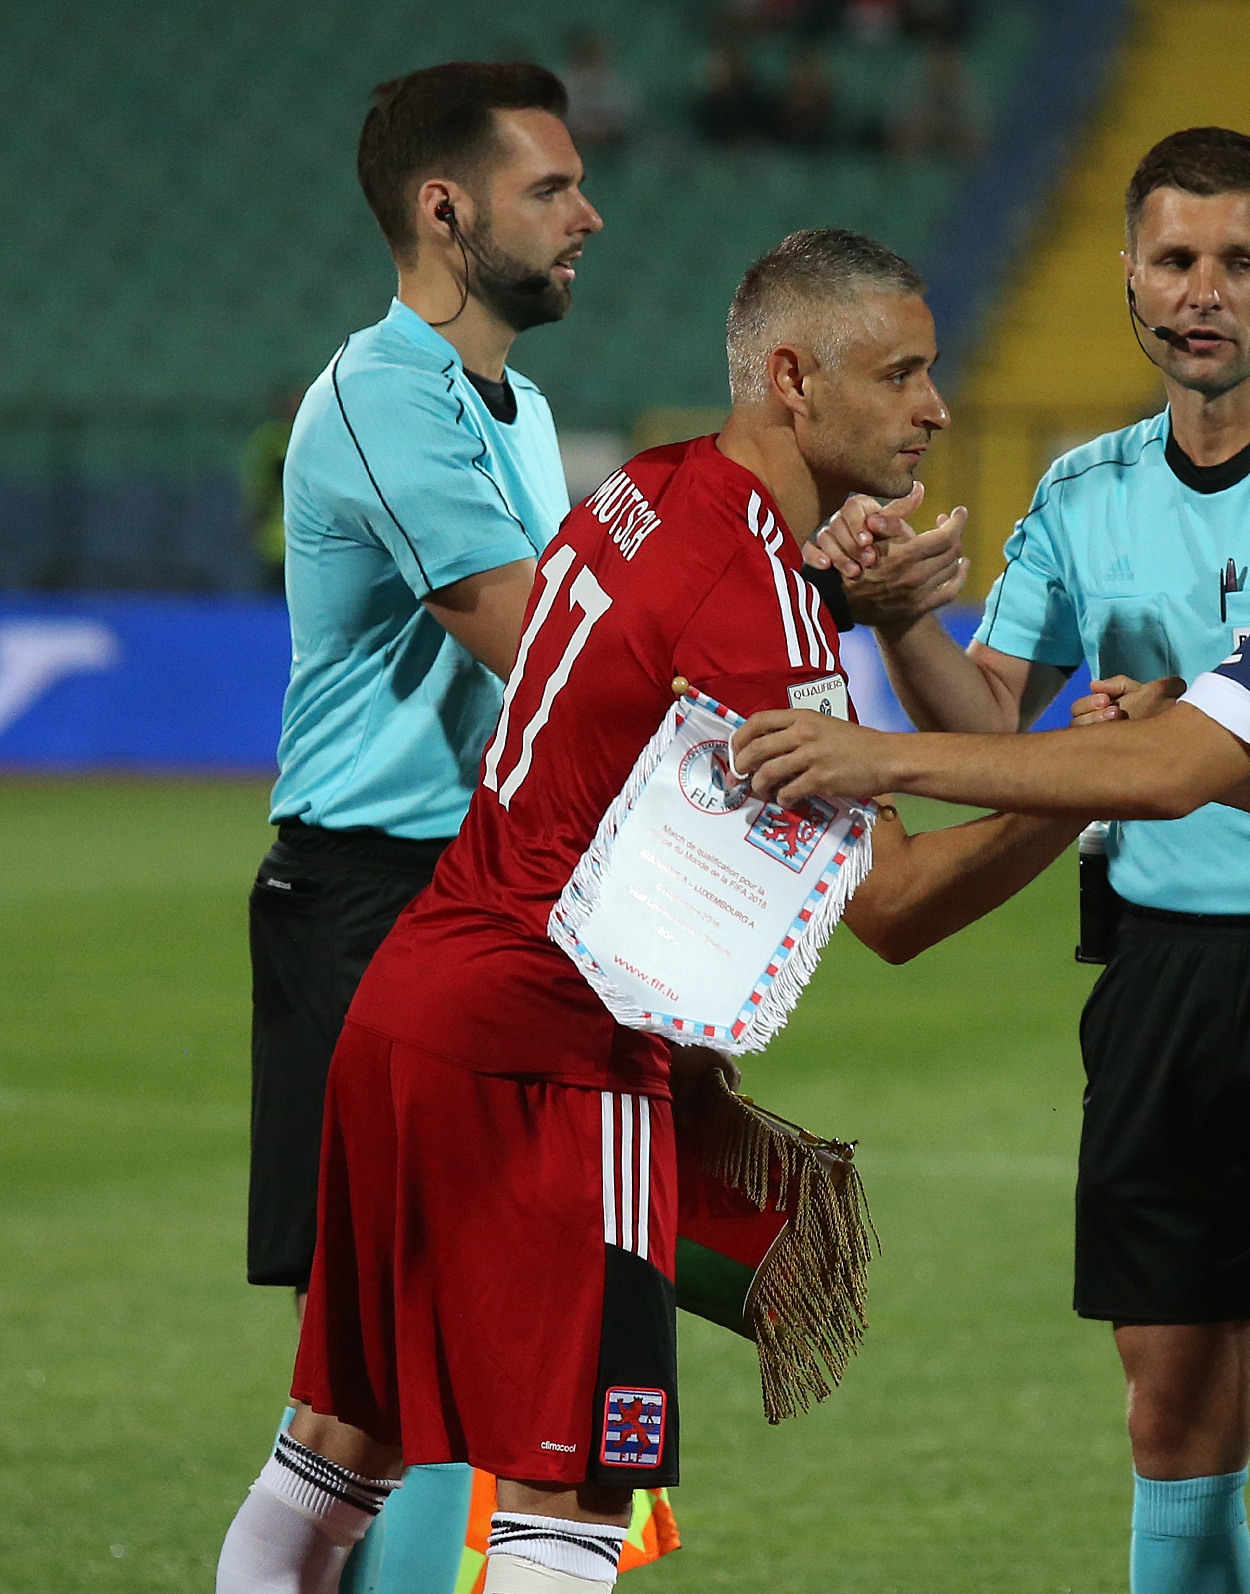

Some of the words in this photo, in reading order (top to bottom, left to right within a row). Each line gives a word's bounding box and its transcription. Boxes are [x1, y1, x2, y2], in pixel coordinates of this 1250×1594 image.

[585, 469, 662, 562] MUTSCH
[482, 543, 613, 812] 17
[793, 679, 843, 700] QUALIFIERS
[690, 787, 718, 809] FLF
[673, 845, 683, 854] du
[684, 852, 709, 870] Monde
[710, 869, 720, 878] de
[729, 881, 747, 895] FIFA
[748, 893, 767, 909] 2018
[686, 840, 696, 849] de
[738, 877, 756, 891] pour
[757, 886, 765, 894] la
[694, 884, 748, 922] LUXEMBOURG
[613, 955, 679, 1001] www.flf.lu
